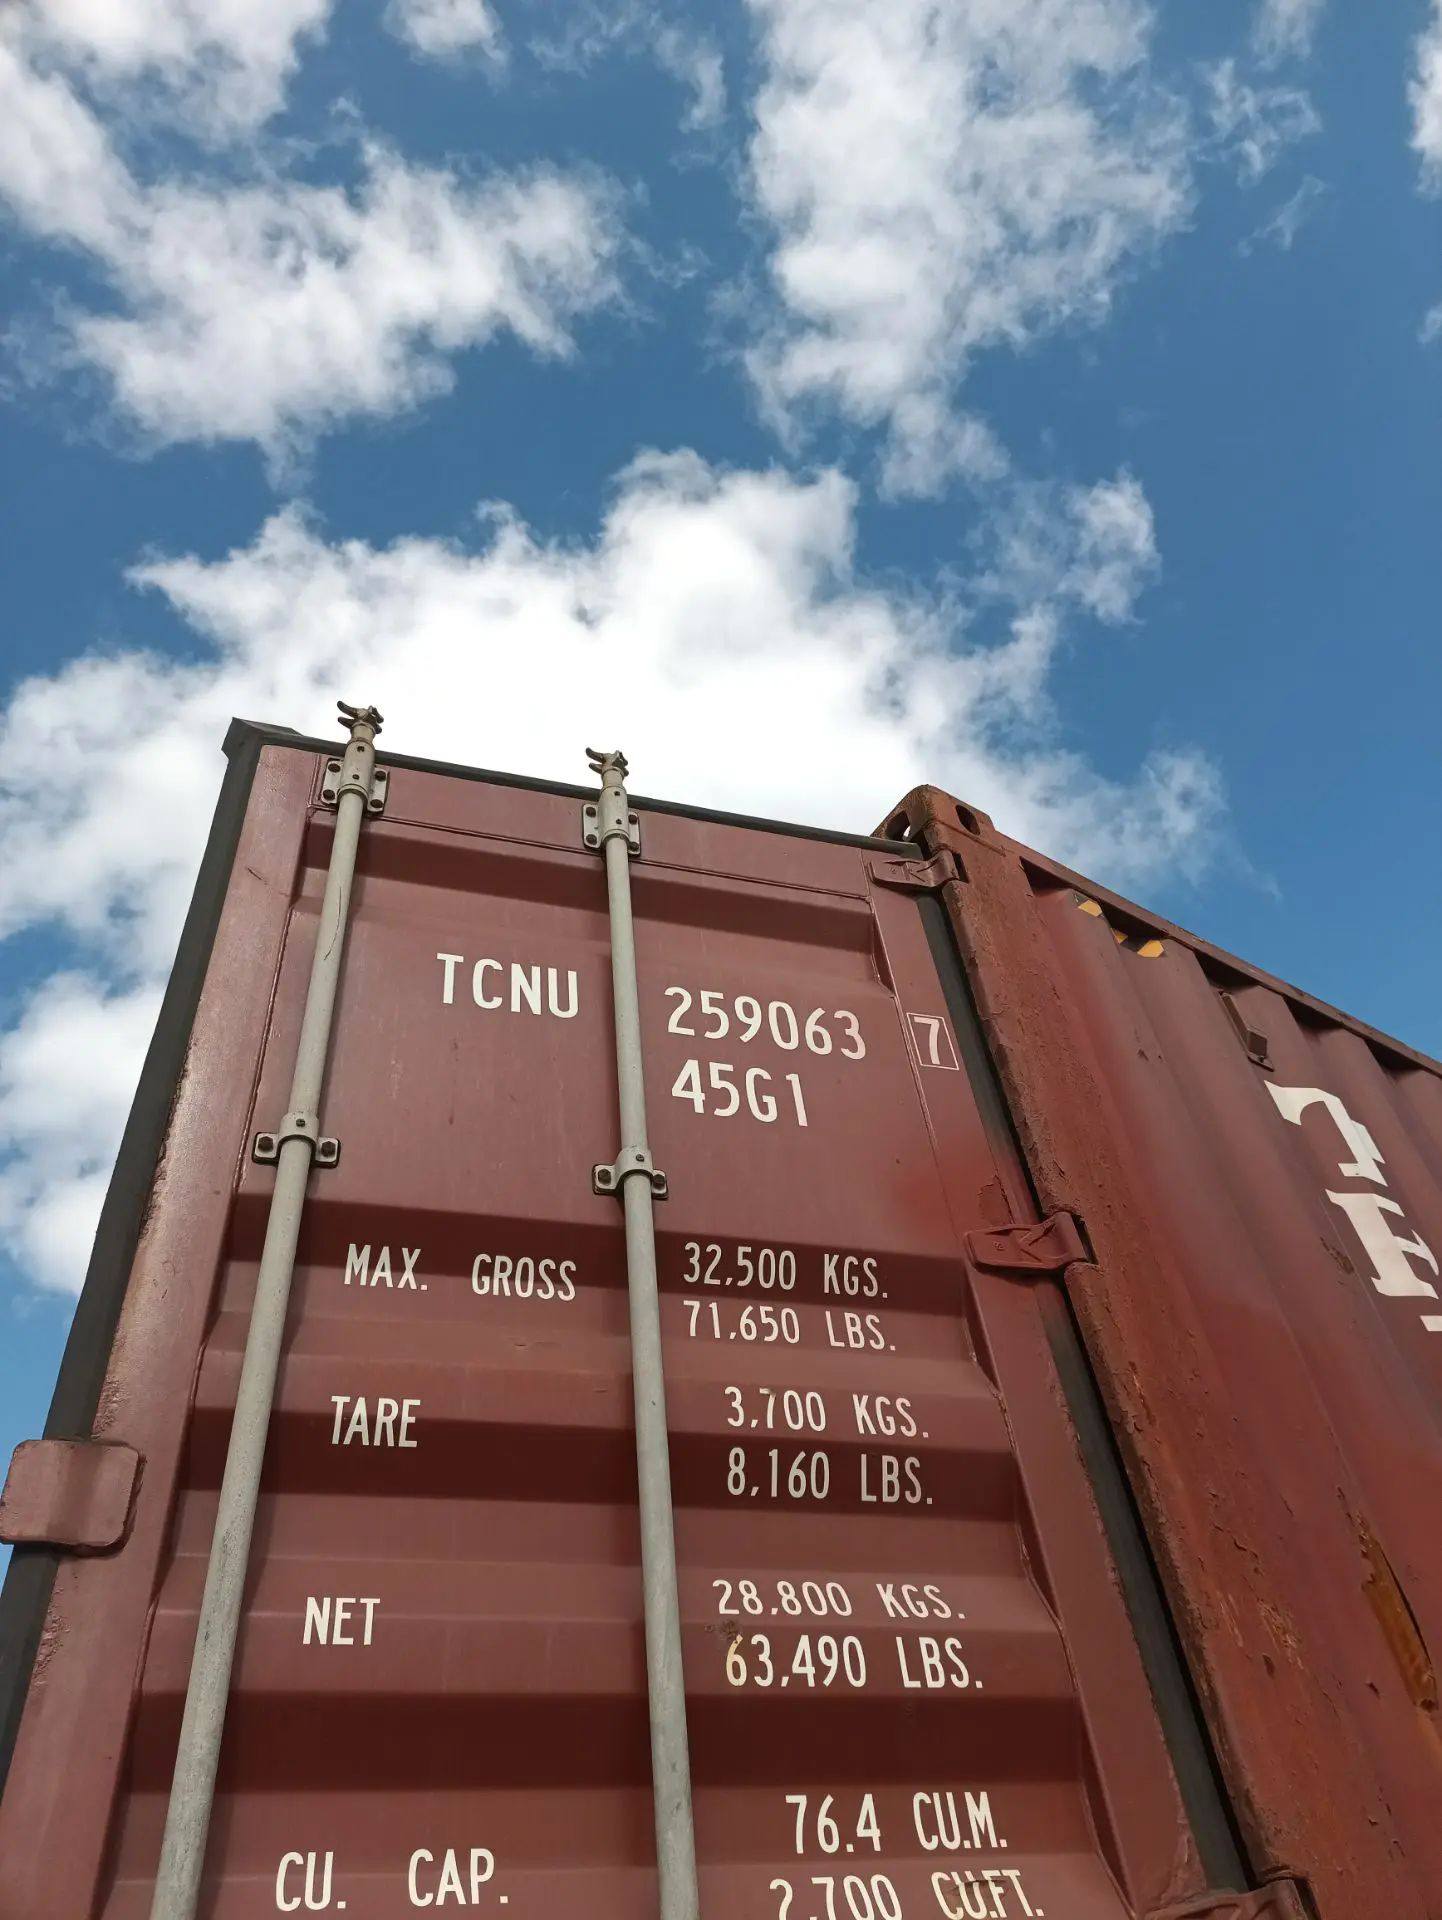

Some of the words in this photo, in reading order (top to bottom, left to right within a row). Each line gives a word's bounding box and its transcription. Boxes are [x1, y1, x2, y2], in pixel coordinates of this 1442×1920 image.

[436, 952, 580, 1019] TCNU
[663, 986, 867, 1060] 259063
[913, 1016, 941, 1065] 7
[671, 1058, 809, 1127] 45G1
[343, 1243, 429, 1291] MAX.
[471, 1253, 578, 1302] GROSS
[683, 1241, 797, 1290] 32,500
[823, 1253, 889, 1299] KGS.
[683, 1299, 801, 1344] 71,650
[825, 1310, 896, 1351] LBS.
[330, 1395, 421, 1448] TARE
[724, 1386, 827, 1432] 3,700
[852, 1393, 930, 1438] KGS.
[727, 1446, 830, 1500] 8,160
[860, 1453, 934, 1506] LBS.
[302, 1597, 381, 1646] NET
[875, 1583, 966, 1620] KGS.
[725, 1633, 867, 1688] 63,490
[895, 1635, 984, 1689] LBS.
[275, 1851, 347, 1912] CU.
[407, 1847, 509, 1908] CAP.
[785, 1793, 881, 1854] 76.4
[912, 1791, 1008, 1851] CU.M.
[931, 1868, 1045, 1920] CU.FT.
